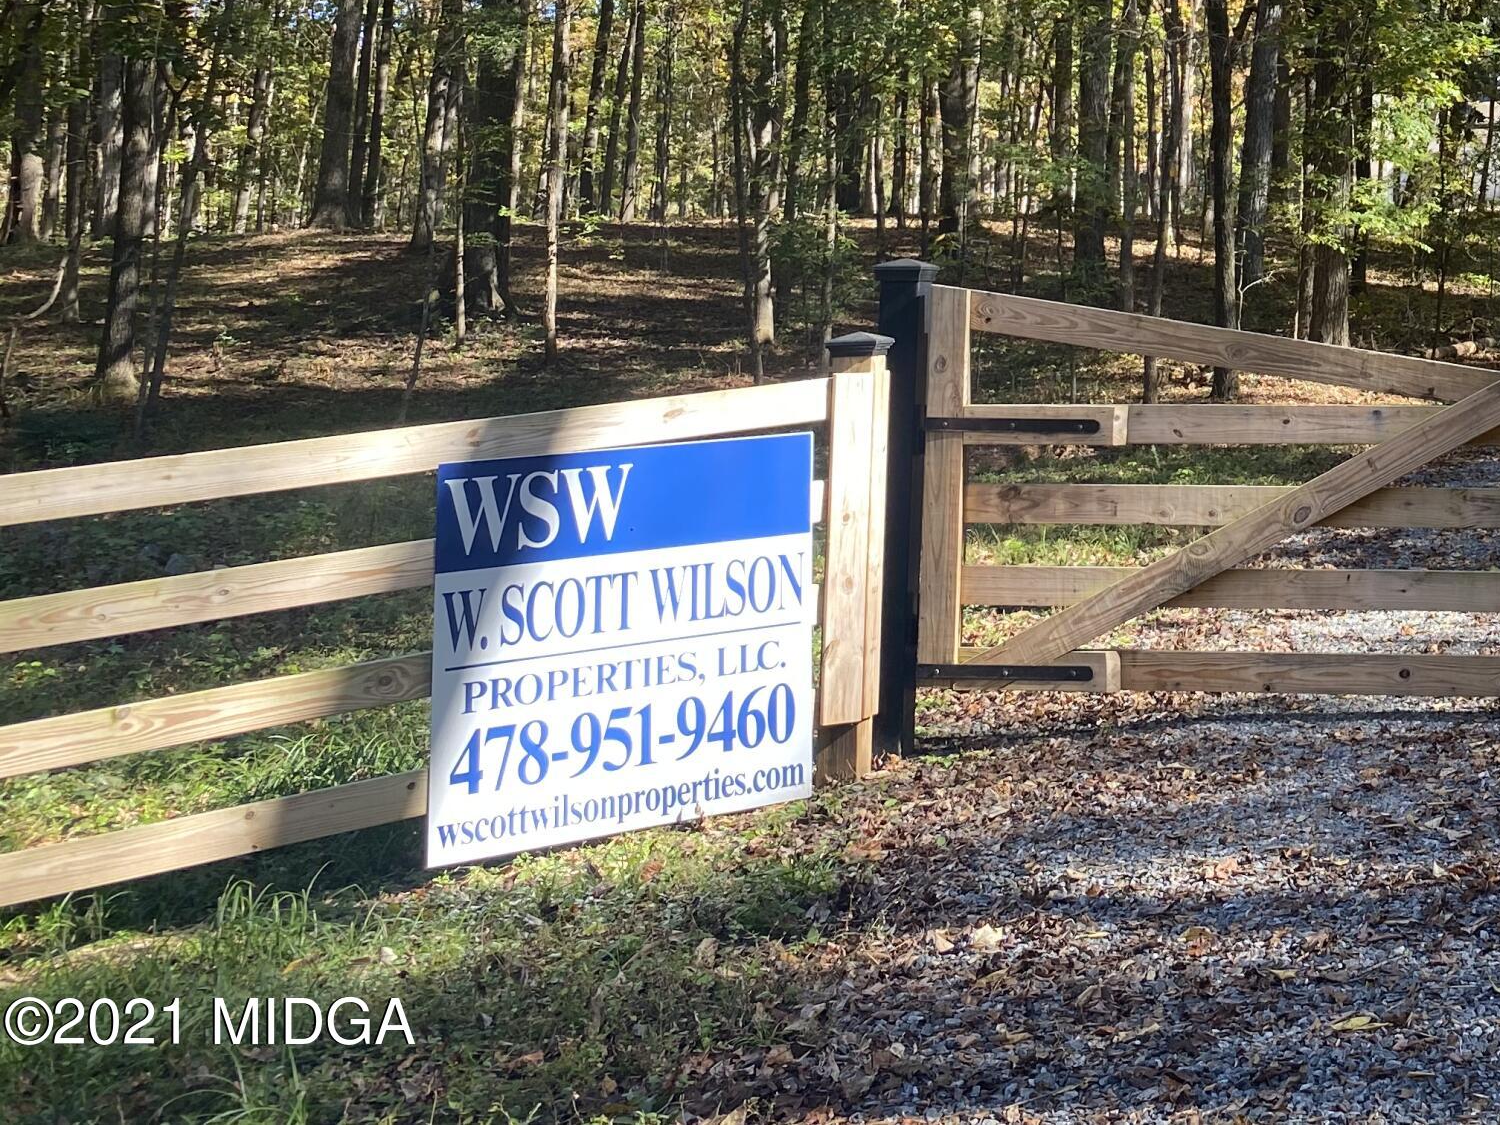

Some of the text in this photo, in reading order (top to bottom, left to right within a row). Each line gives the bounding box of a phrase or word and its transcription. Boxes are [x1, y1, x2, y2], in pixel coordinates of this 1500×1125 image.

[444, 463, 633, 556] WSW
[442, 552, 805, 654] W. SCOTT WILSON
[462, 640, 786, 715] PROPERTIES, LLC.
[449, 682, 796, 795] 478-951-9460
[437, 762, 805, 849] wscottwilsonproperties.com
